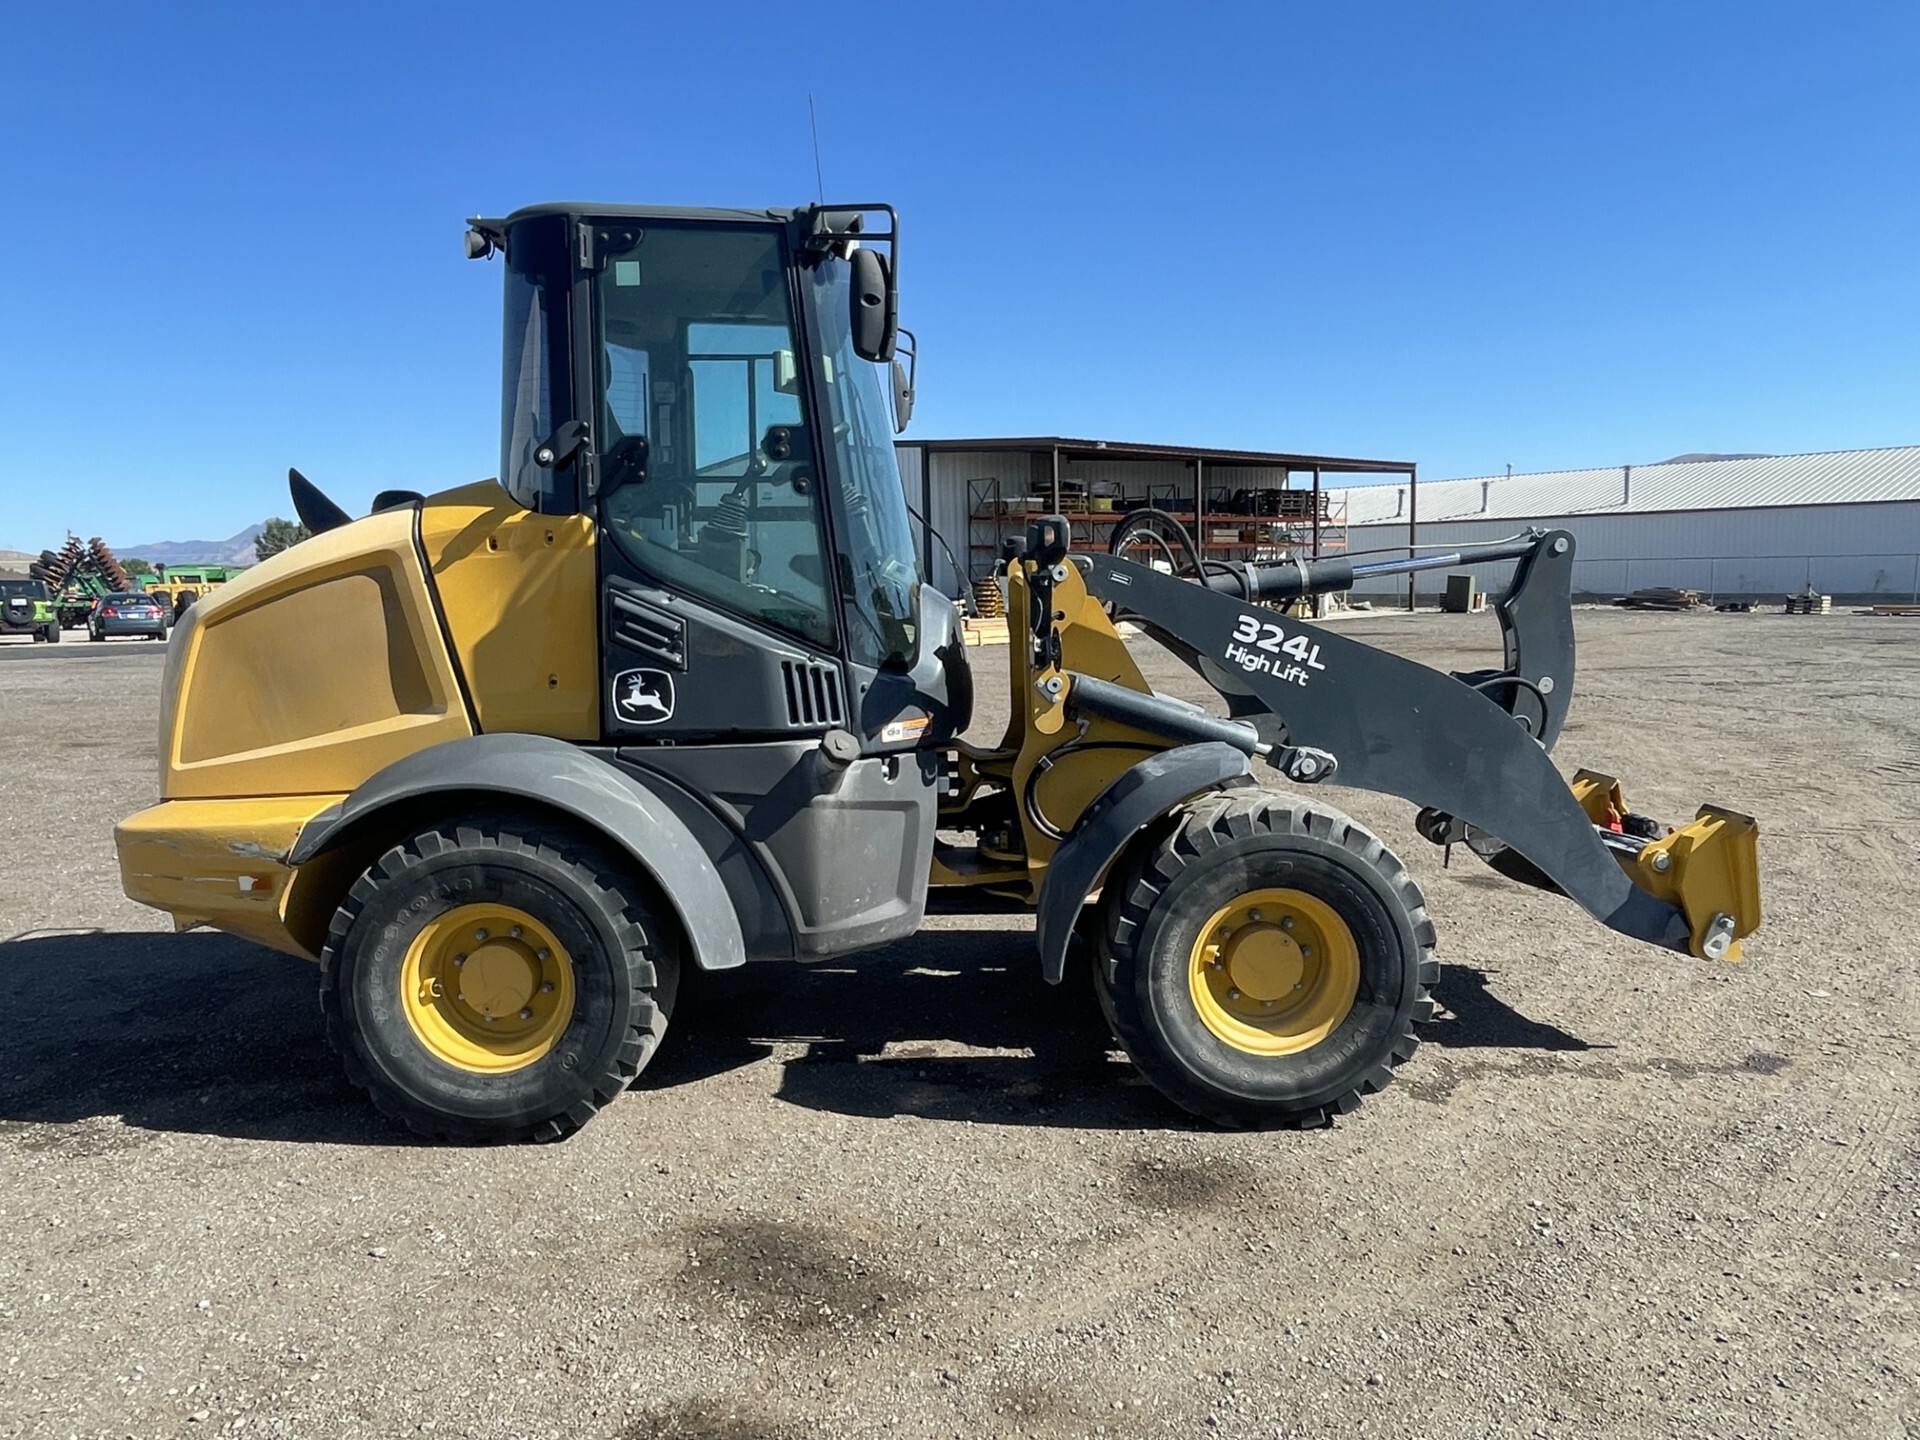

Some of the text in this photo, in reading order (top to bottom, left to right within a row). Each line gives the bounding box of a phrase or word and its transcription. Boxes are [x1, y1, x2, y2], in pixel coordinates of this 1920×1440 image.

[1224, 642, 1310, 687] High Lift
[1232, 614, 1326, 671] 324L
